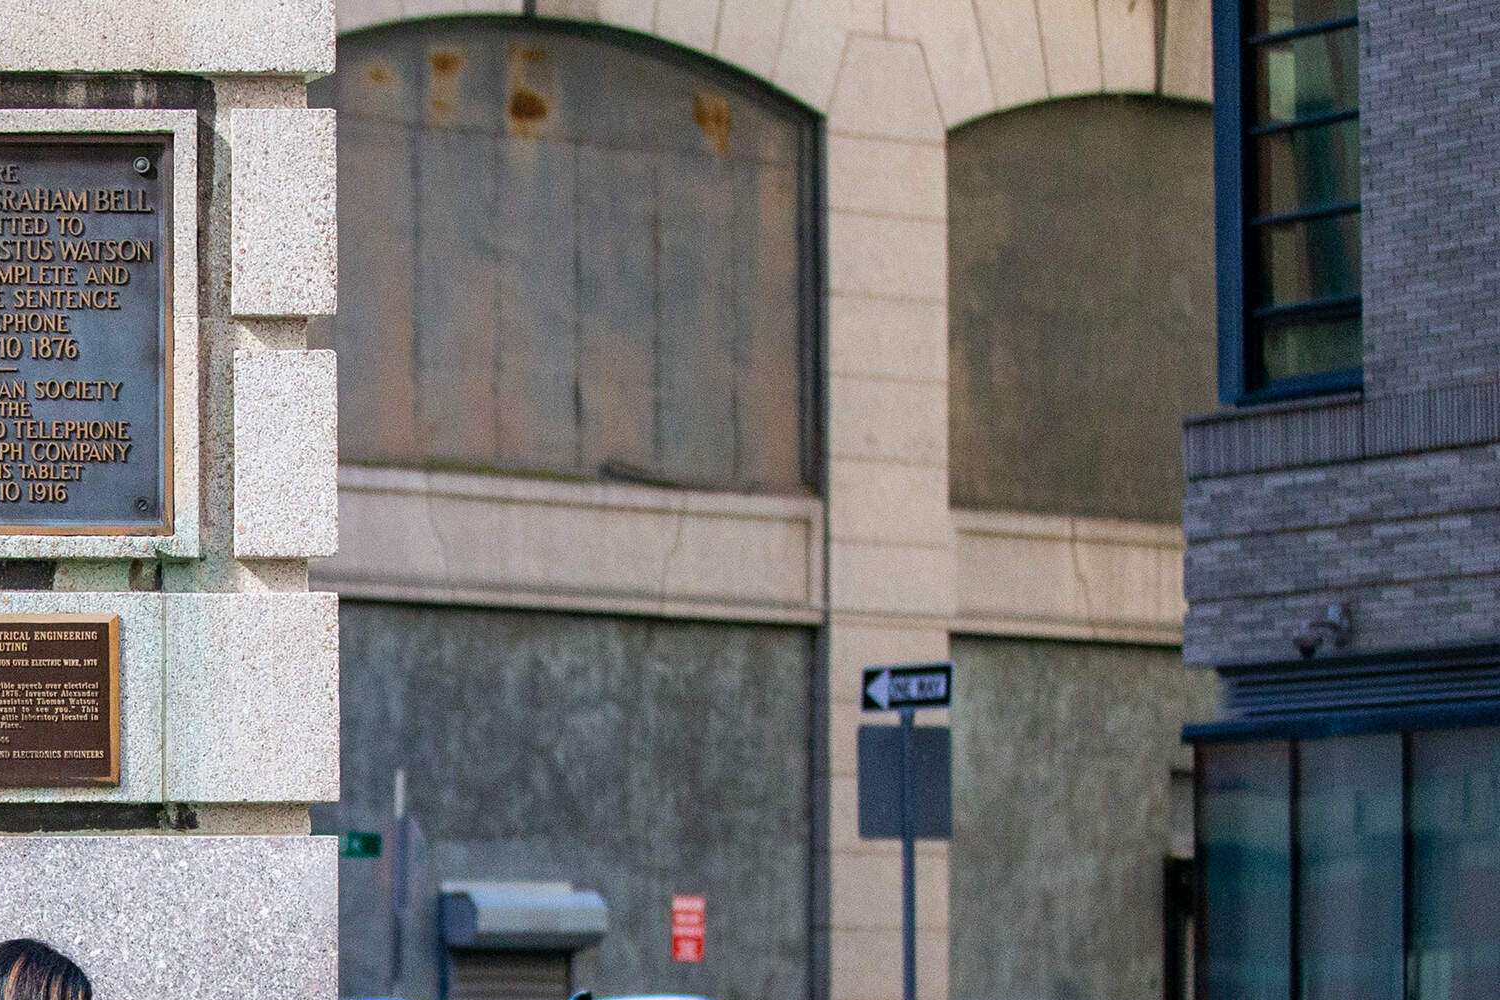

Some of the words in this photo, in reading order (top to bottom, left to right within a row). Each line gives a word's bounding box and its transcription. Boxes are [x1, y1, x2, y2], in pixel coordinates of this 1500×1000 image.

[94, 189, 153, 212] BELL
[56, 217, 83, 236] TO
[60, 240, 152, 261] WATSON
[86, 266, 129, 285] AND
[14, 290, 120, 309] SENTENCE
[0, 338, 20, 358] 10
[31, 338, 78, 358] 1876
[35, 381, 121, 399] SOCIETY
[0, 402, 30, 417] THE
[14, 421, 130, 439] TELEPHONE
[32, 443, 130, 461] COMPANY
[20, 464, 83, 479] TABLET
[0, 483, 19, 501] 10
[28, 483, 67, 501] 1916
[34, 631, 98, 641] ENGINEERING
[12, 659, 29, 667] OVER
[31, 659, 62, 667] ELECTRIC
[17, 682, 42, 691] speech
[45, 682, 61, 690] over
[64, 682, 99, 690] electrical
[25, 690, 58, 698] Inventor
[60, 690, 99, 698] Alexander
[21, 706, 30, 714] to
[35, 706, 49, 714] see
[81, 706, 99, 714] This
[36, 698, 65, 706] Thomas
[12, 751, 61, 759] ELECTRONICS
[64, 751, 104, 759] ENGINEERS
